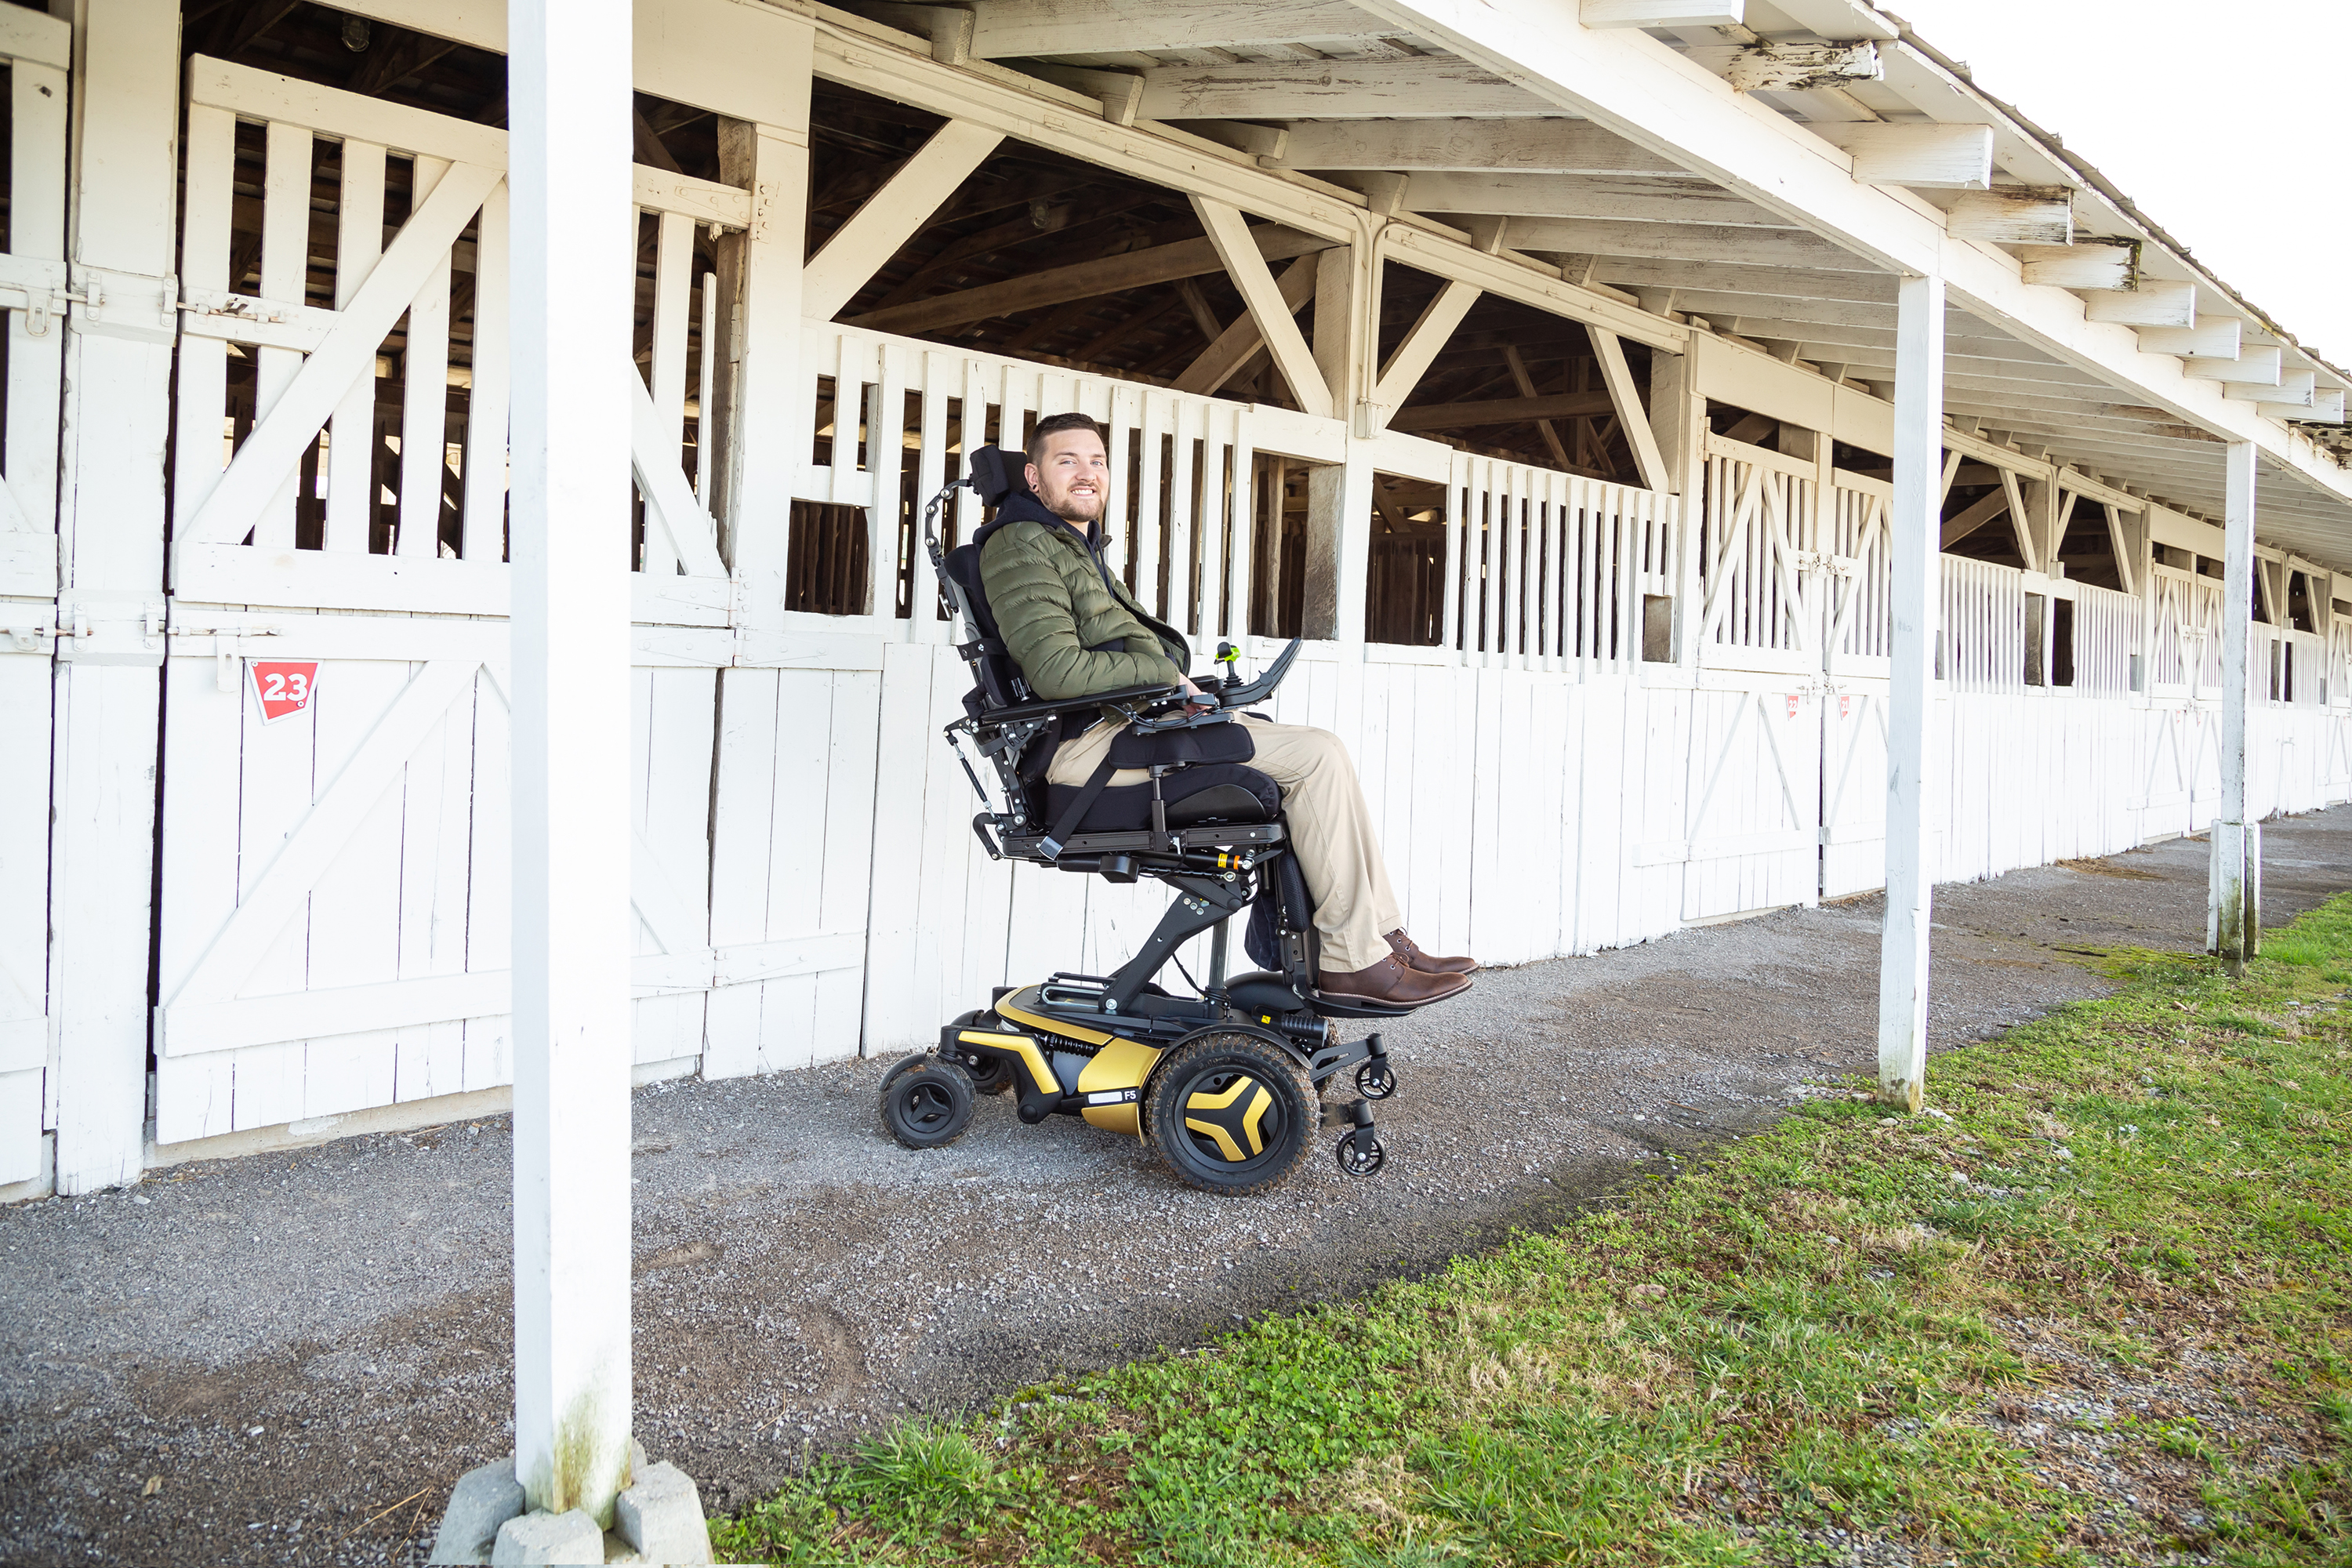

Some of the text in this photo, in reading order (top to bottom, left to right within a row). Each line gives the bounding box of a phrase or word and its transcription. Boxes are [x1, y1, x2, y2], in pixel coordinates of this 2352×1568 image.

[263, 673, 308, 701] 23
[1788, 699, 1798, 711] 22
[1841, 700, 1849, 711] 21
[1124, 1090, 1137, 1101] F5
